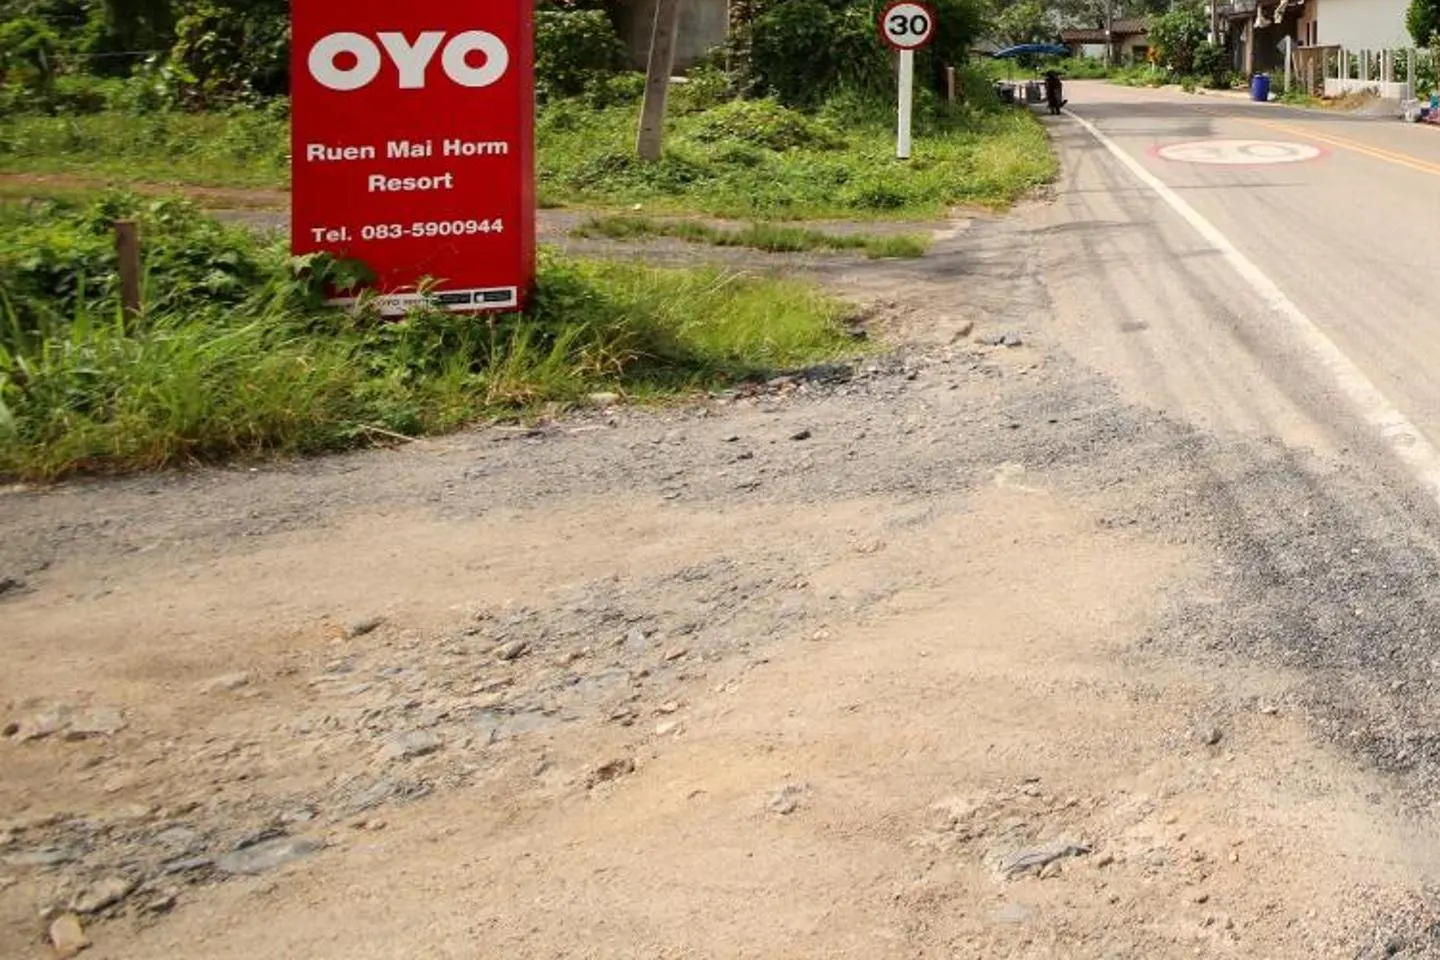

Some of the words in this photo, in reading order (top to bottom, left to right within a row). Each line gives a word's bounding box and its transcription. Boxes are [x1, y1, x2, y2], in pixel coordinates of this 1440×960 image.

[890, 15, 928, 36] 30
[308, 30, 509, 91] OYO
[306, 143, 376, 162] Ruen
[387, 140, 433, 158] Mai
[442, 139, 509, 156] Horm
[368, 172, 453, 192] Resort
[311, 227, 352, 242] Tel.
[361, 218, 504, 240] 083-5900944
